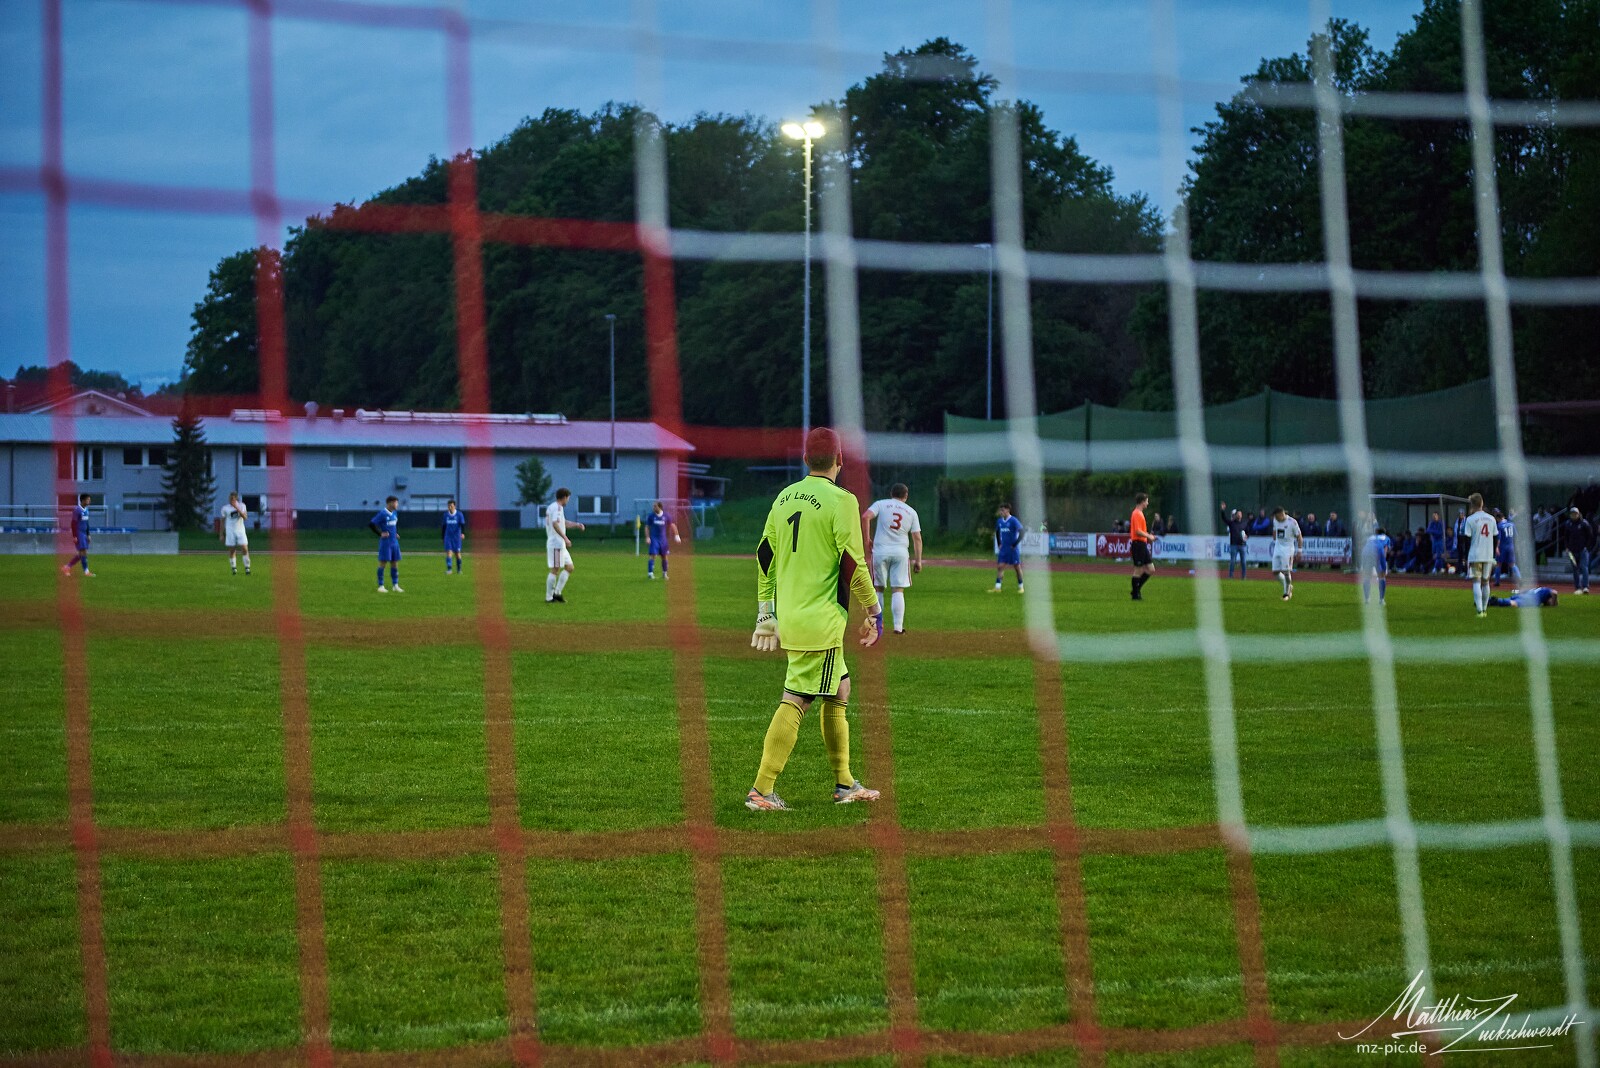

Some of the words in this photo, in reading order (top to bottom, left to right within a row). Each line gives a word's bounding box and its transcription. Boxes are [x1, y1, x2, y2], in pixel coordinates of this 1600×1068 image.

[780, 492, 792, 506] SV
[794, 491, 822, 510] Laufen
[890, 512, 903, 530] 3
[786, 510, 803, 553] 1
[1481, 524, 1490, 537] 4
[1504, 527, 1514, 537] 10
